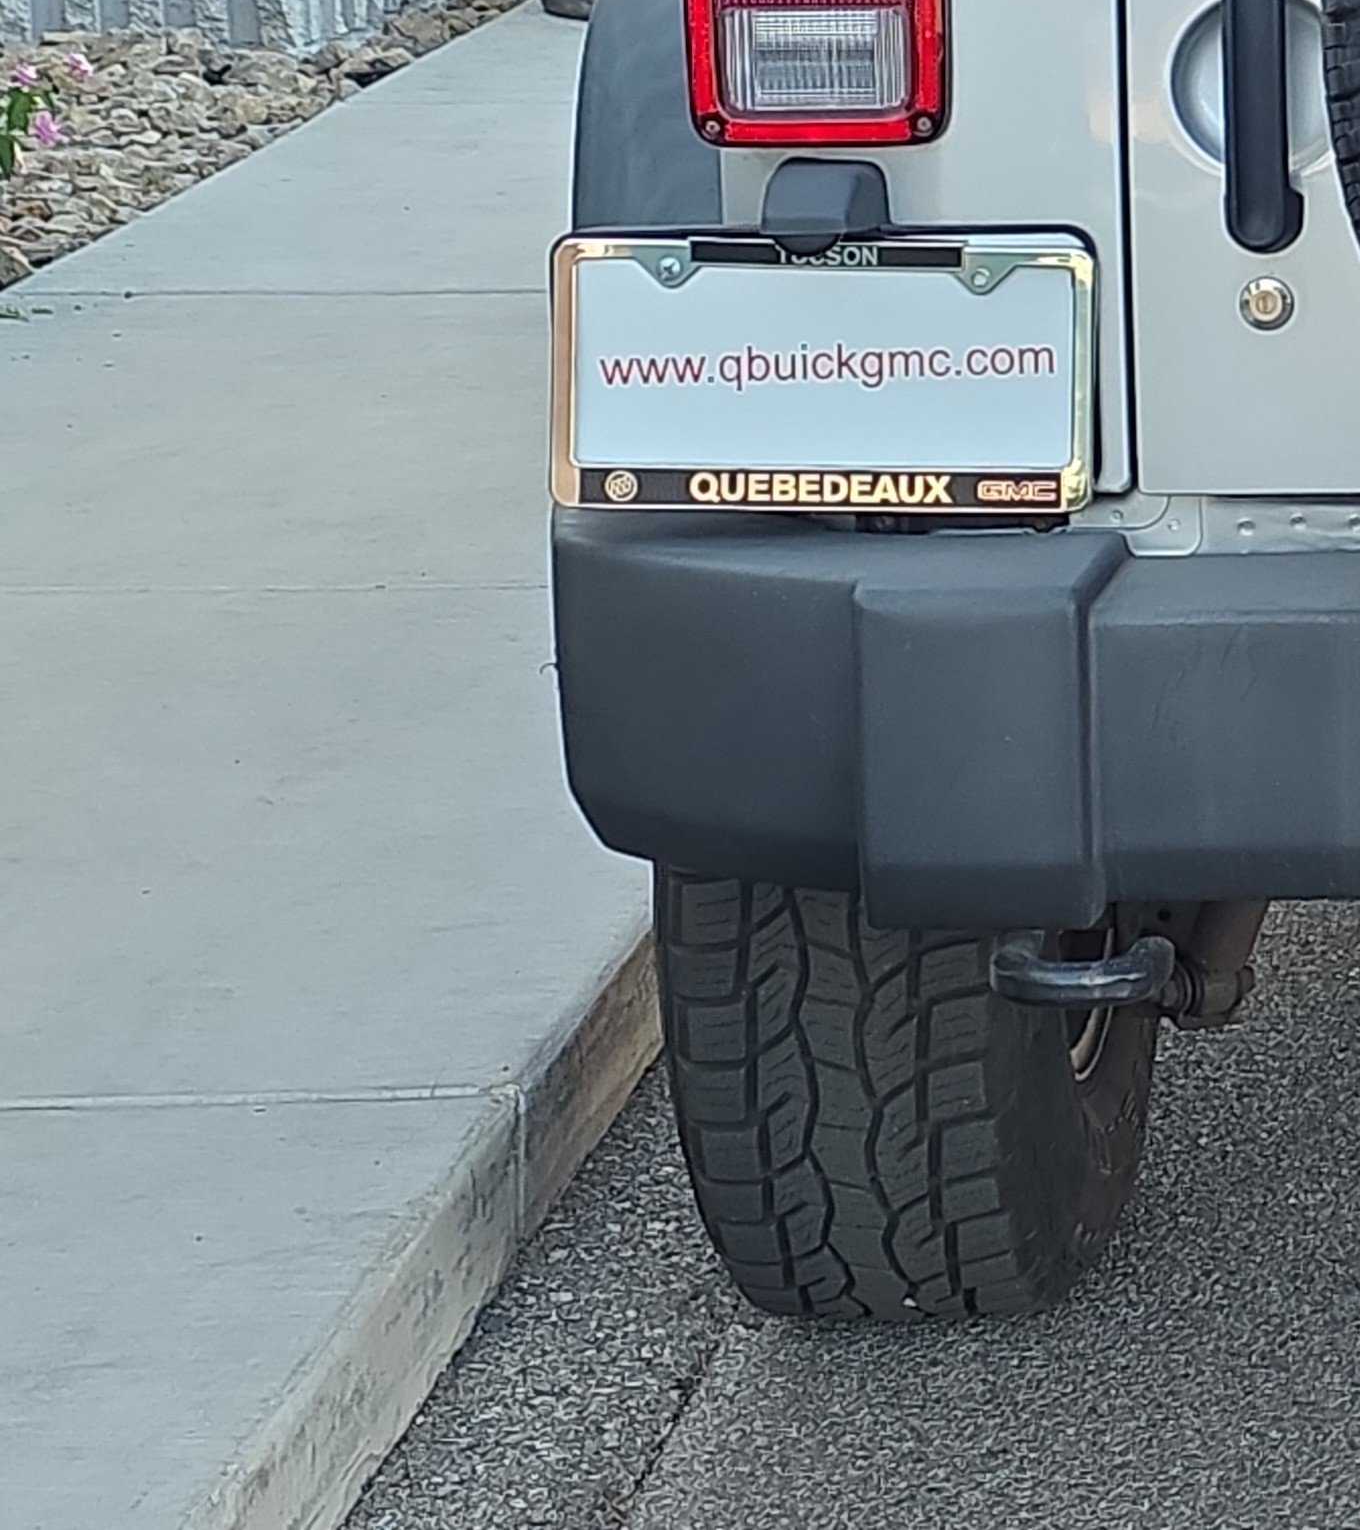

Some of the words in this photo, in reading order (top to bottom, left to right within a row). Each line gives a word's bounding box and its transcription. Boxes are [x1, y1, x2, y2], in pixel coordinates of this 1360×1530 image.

[598, 343, 1057, 391] www.qbuickgmc.com
[689, 471, 953, 506] QUEBEDEAUX
[977, 480, 1057, 502] GMC
